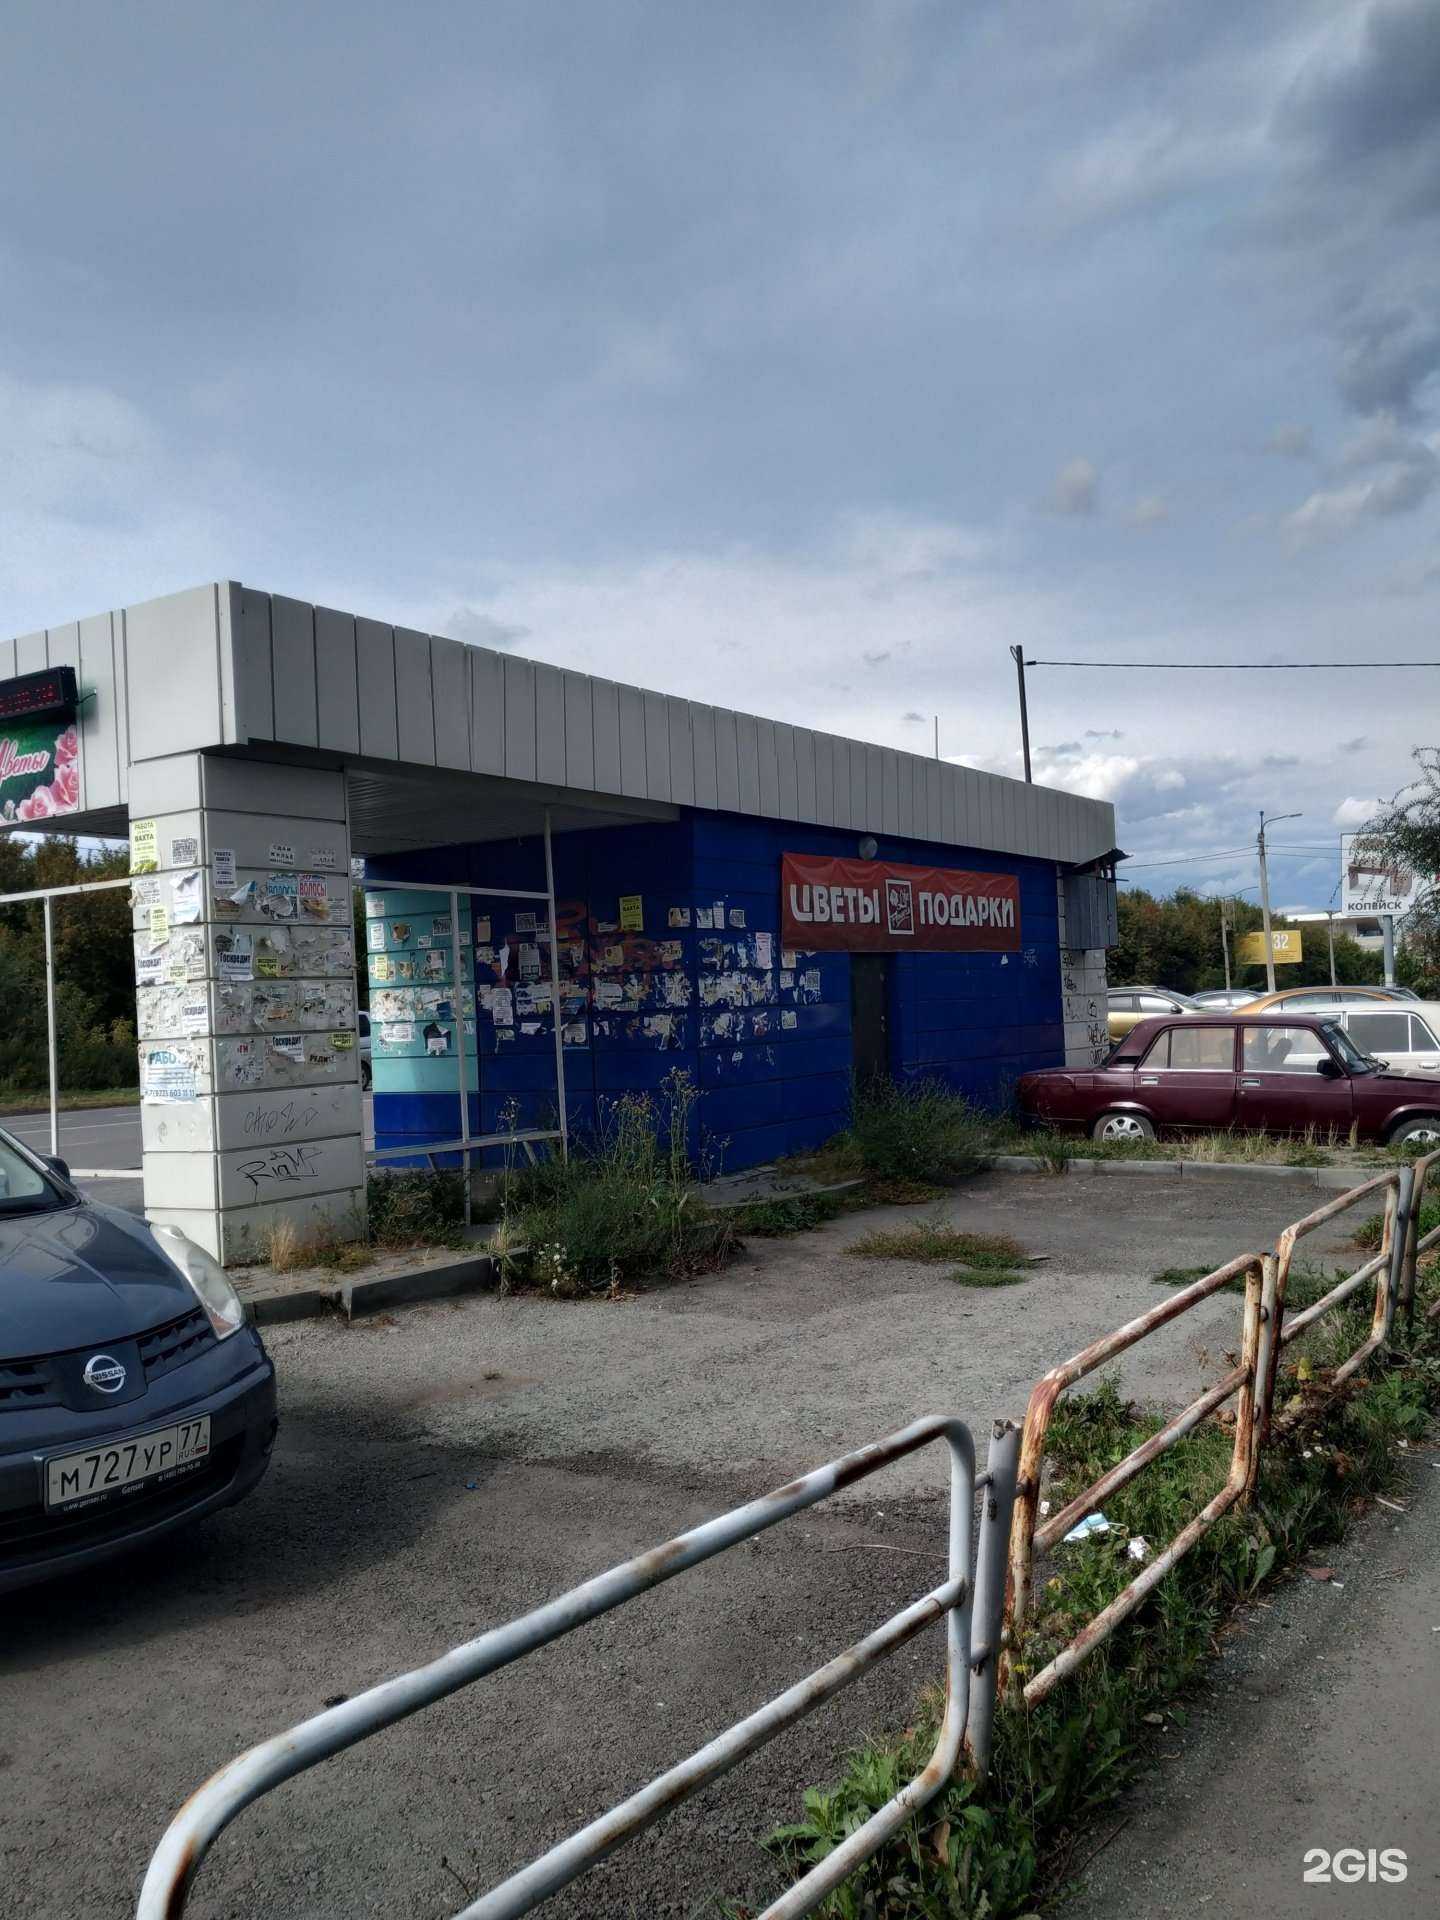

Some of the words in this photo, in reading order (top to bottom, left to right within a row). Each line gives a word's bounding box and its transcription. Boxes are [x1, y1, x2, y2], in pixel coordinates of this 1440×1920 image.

[299, 882, 327, 897] ВОЛОСЫ
[790, 884, 881, 924] ЦВЕТЫ
[918, 891, 1015, 928] ПОДАРКИ
[219, 953, 251, 964] Госкредит
[272, 1036, 302, 1047] Госкредит
[90, 1366, 125, 1382] NISSAN
[181, 1421, 202, 1447] 77
[178, 1447, 195, 1461] RUS
